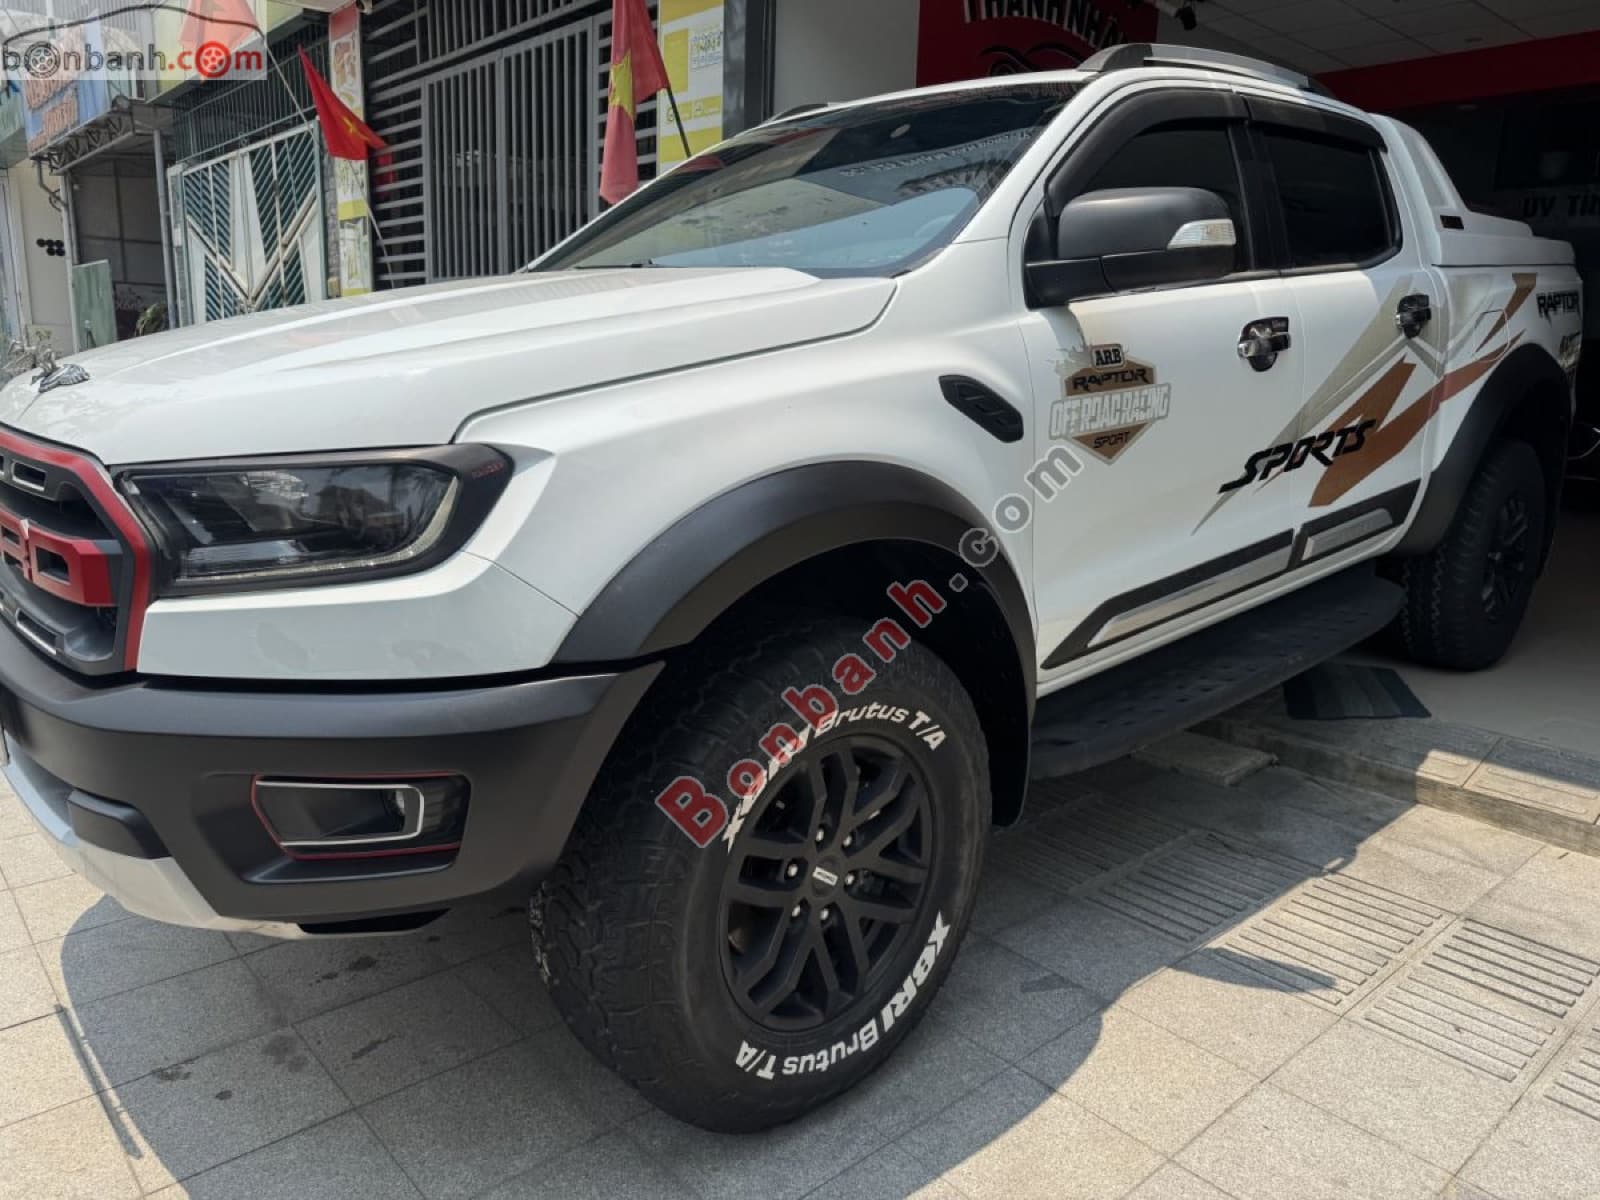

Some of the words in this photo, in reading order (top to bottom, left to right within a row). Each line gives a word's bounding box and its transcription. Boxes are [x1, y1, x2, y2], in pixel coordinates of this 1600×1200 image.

[1536, 289, 1582, 321] RAPTOR
[1095, 348, 1122, 366] ARB
[1072, 368, 1151, 393] RAPTOR
[1093, 431, 1131, 449] SPORT
[1219, 419, 1376, 493] SPORTS
[815, 701, 909, 738] Brutus
[908, 710, 948, 750] T/A
[880, 910, 951, 1033] XBRI
[735, 1040, 777, 1081] T/A
[782, 1018, 879, 1075] Brutus
